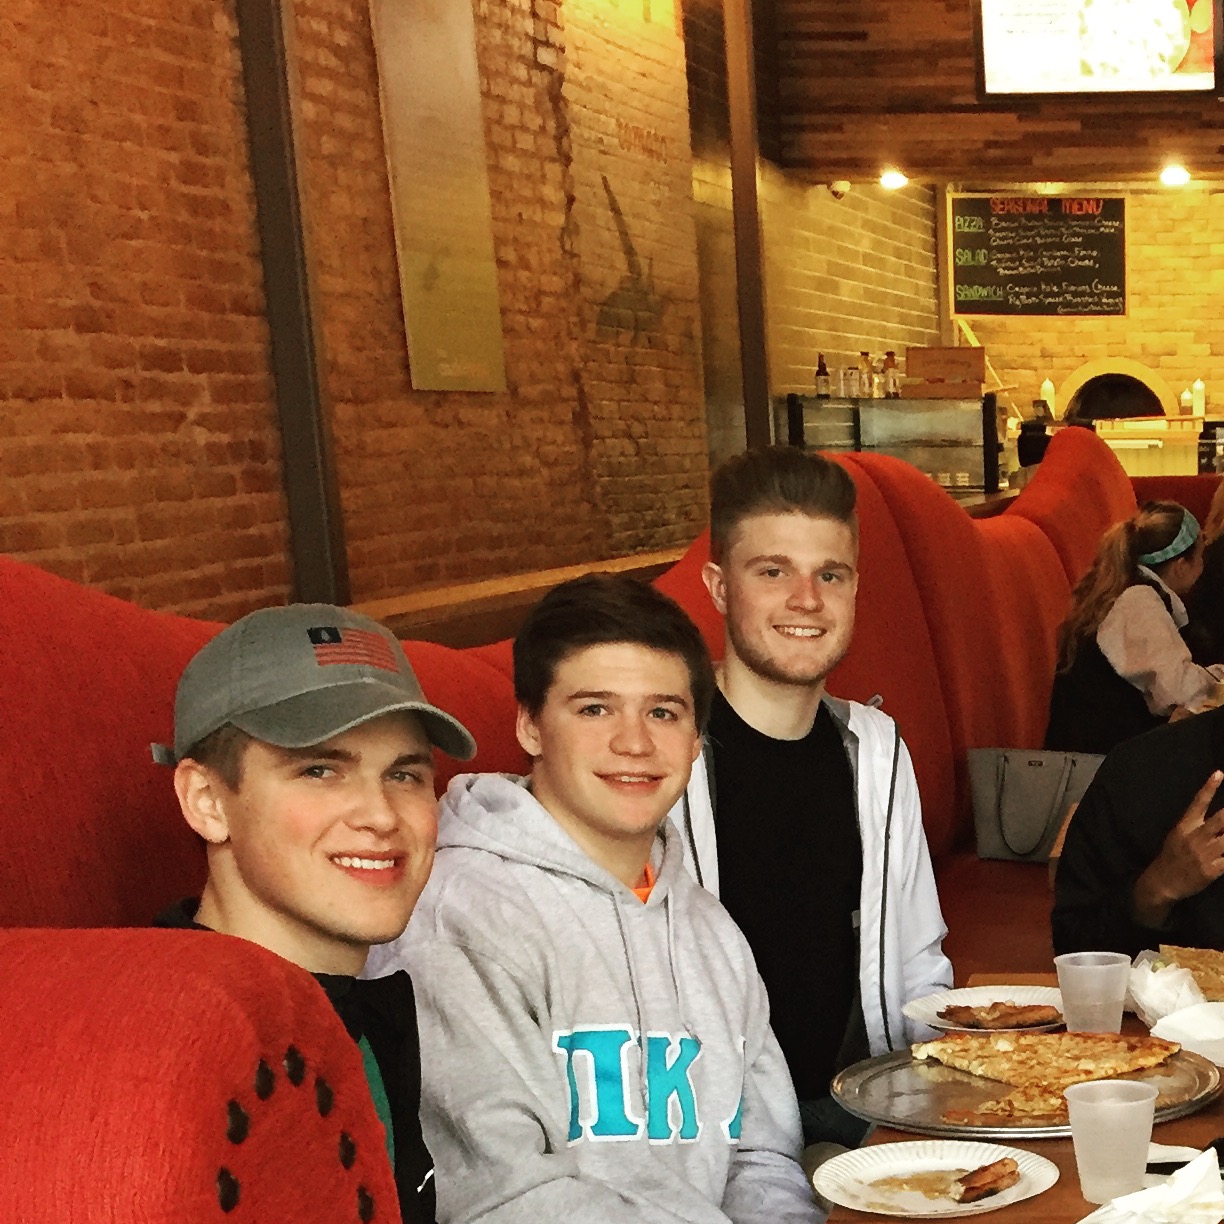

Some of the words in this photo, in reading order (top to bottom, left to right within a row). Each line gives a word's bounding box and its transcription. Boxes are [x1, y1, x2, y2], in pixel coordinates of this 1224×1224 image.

[1062, 198, 1104, 215] MENU
[955, 215, 984, 230] PIZZA
[955, 248, 988, 264] SALAD
[955, 284, 1003, 299] SANDWICH
